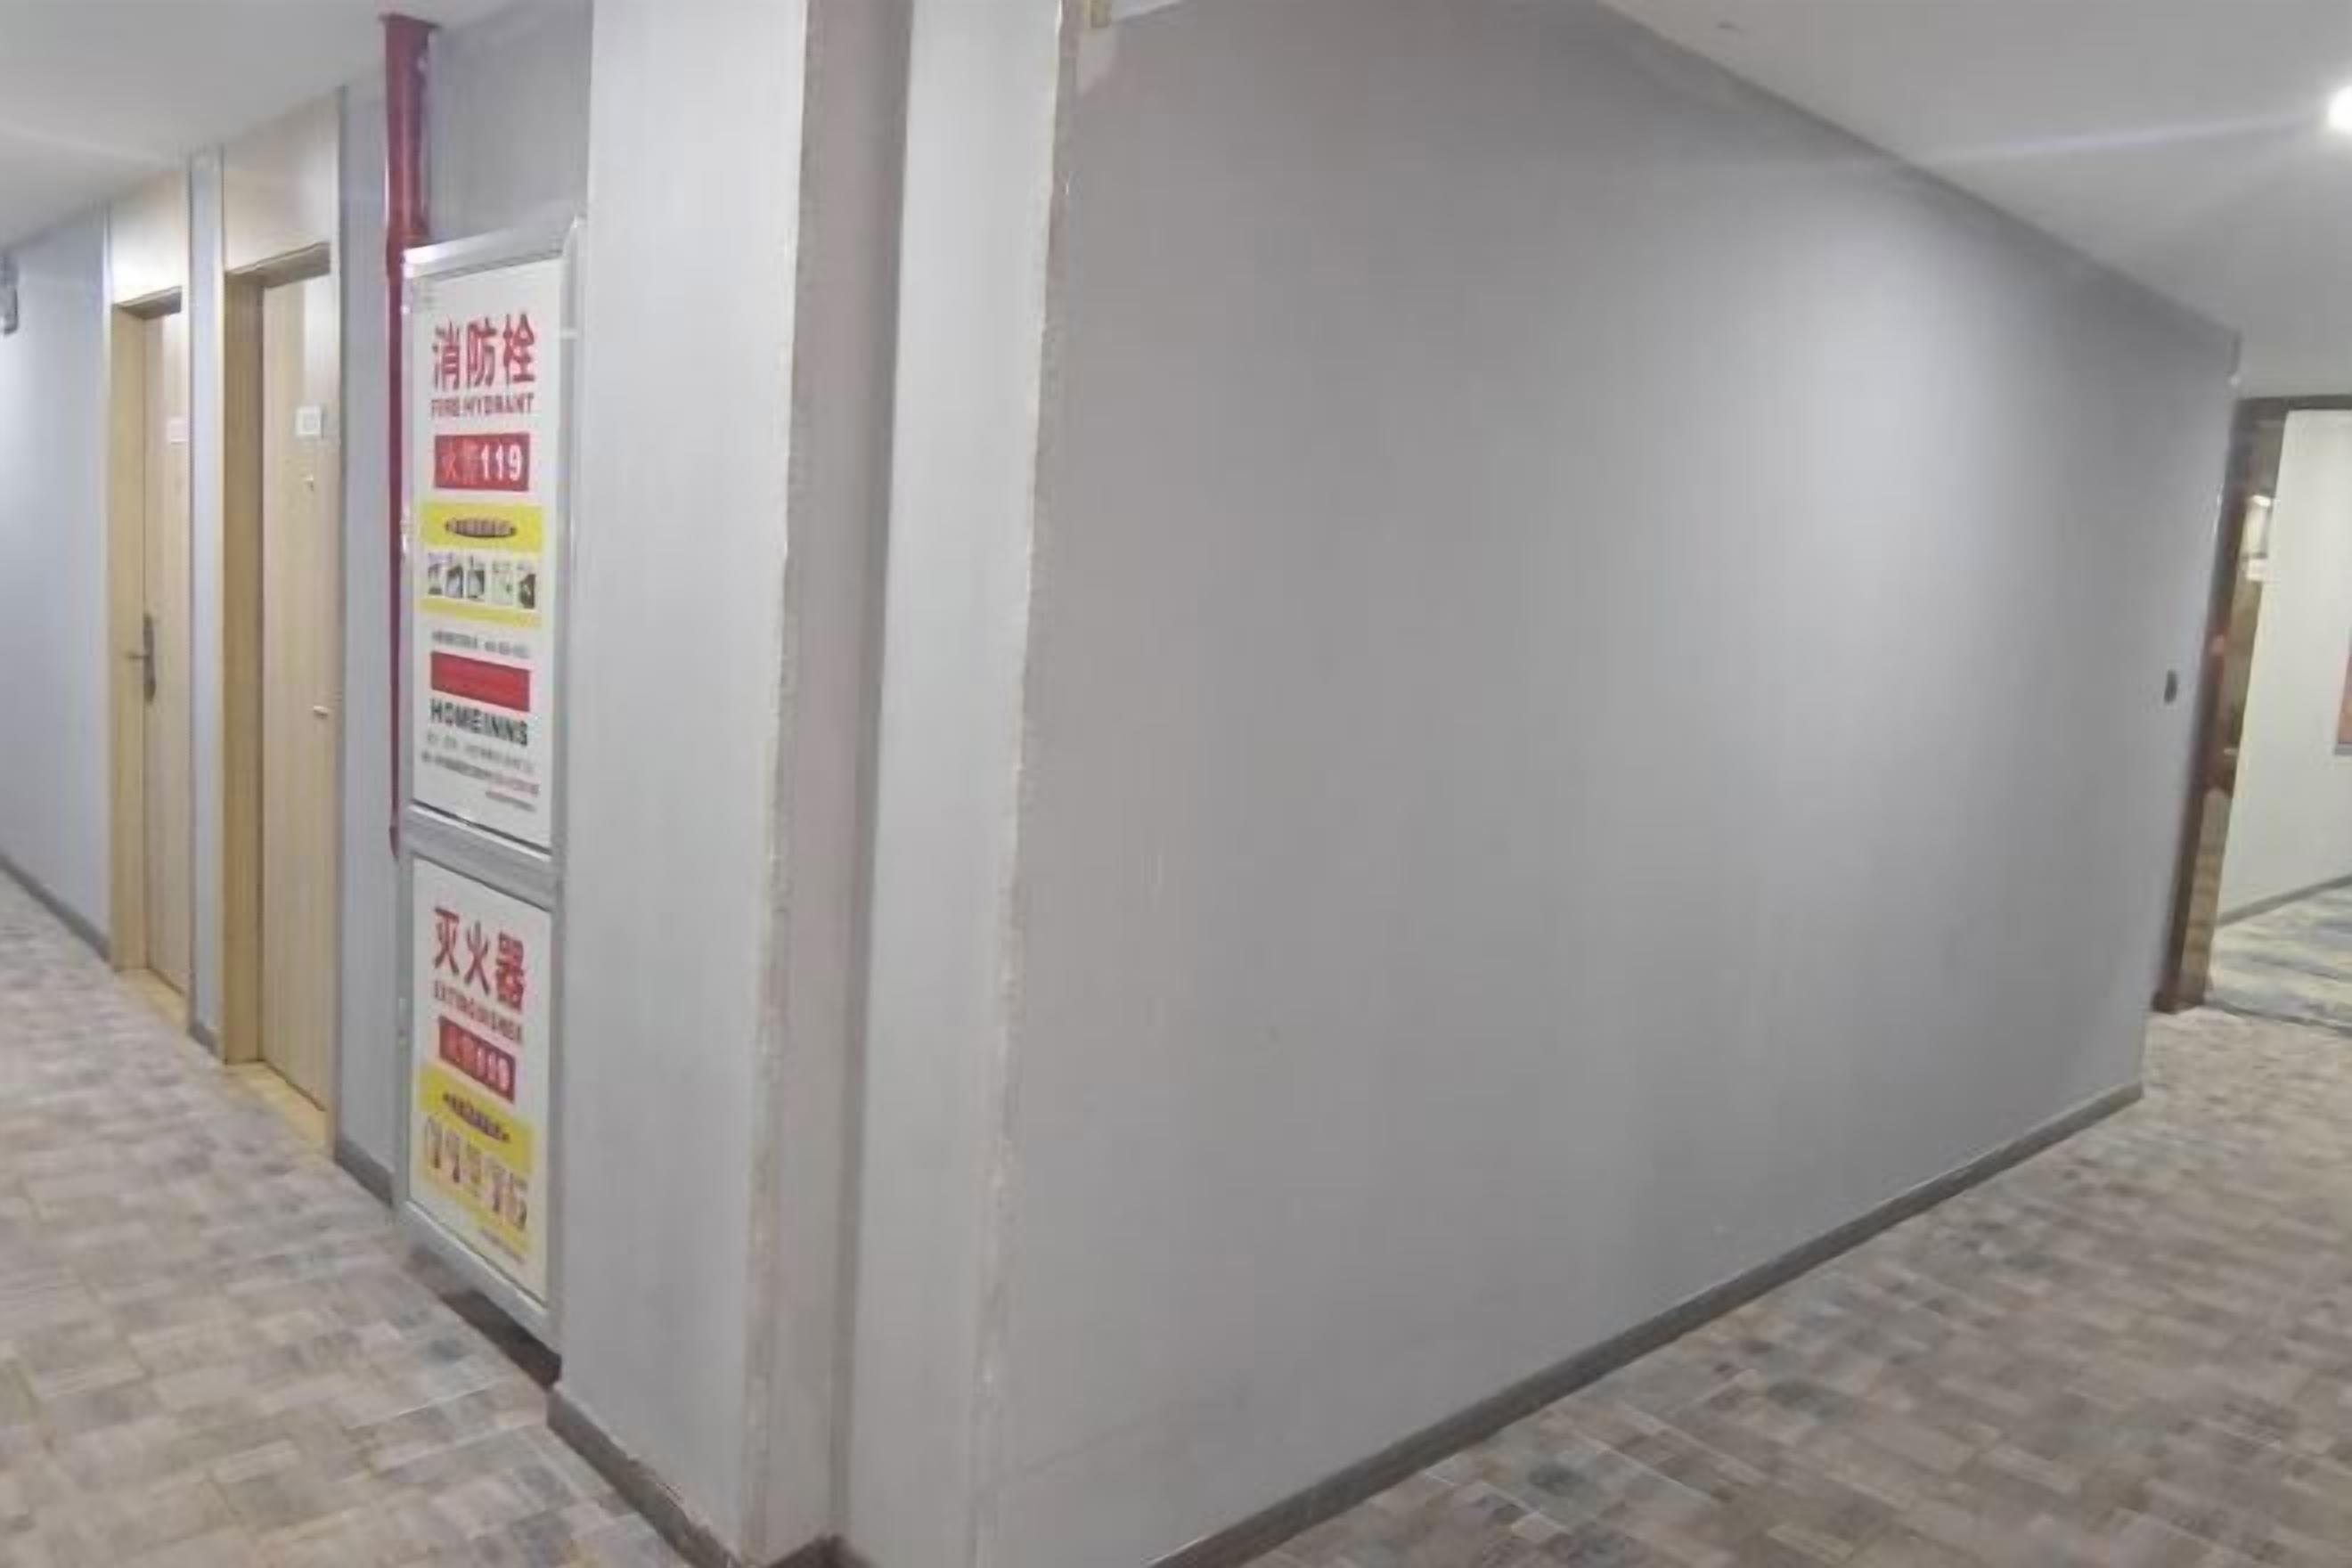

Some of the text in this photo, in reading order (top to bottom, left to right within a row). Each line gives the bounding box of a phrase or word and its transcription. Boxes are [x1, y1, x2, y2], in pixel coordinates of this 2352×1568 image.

[432, 314, 535, 390] 消防栓
[433, 906, 525, 1011] 灭火器
